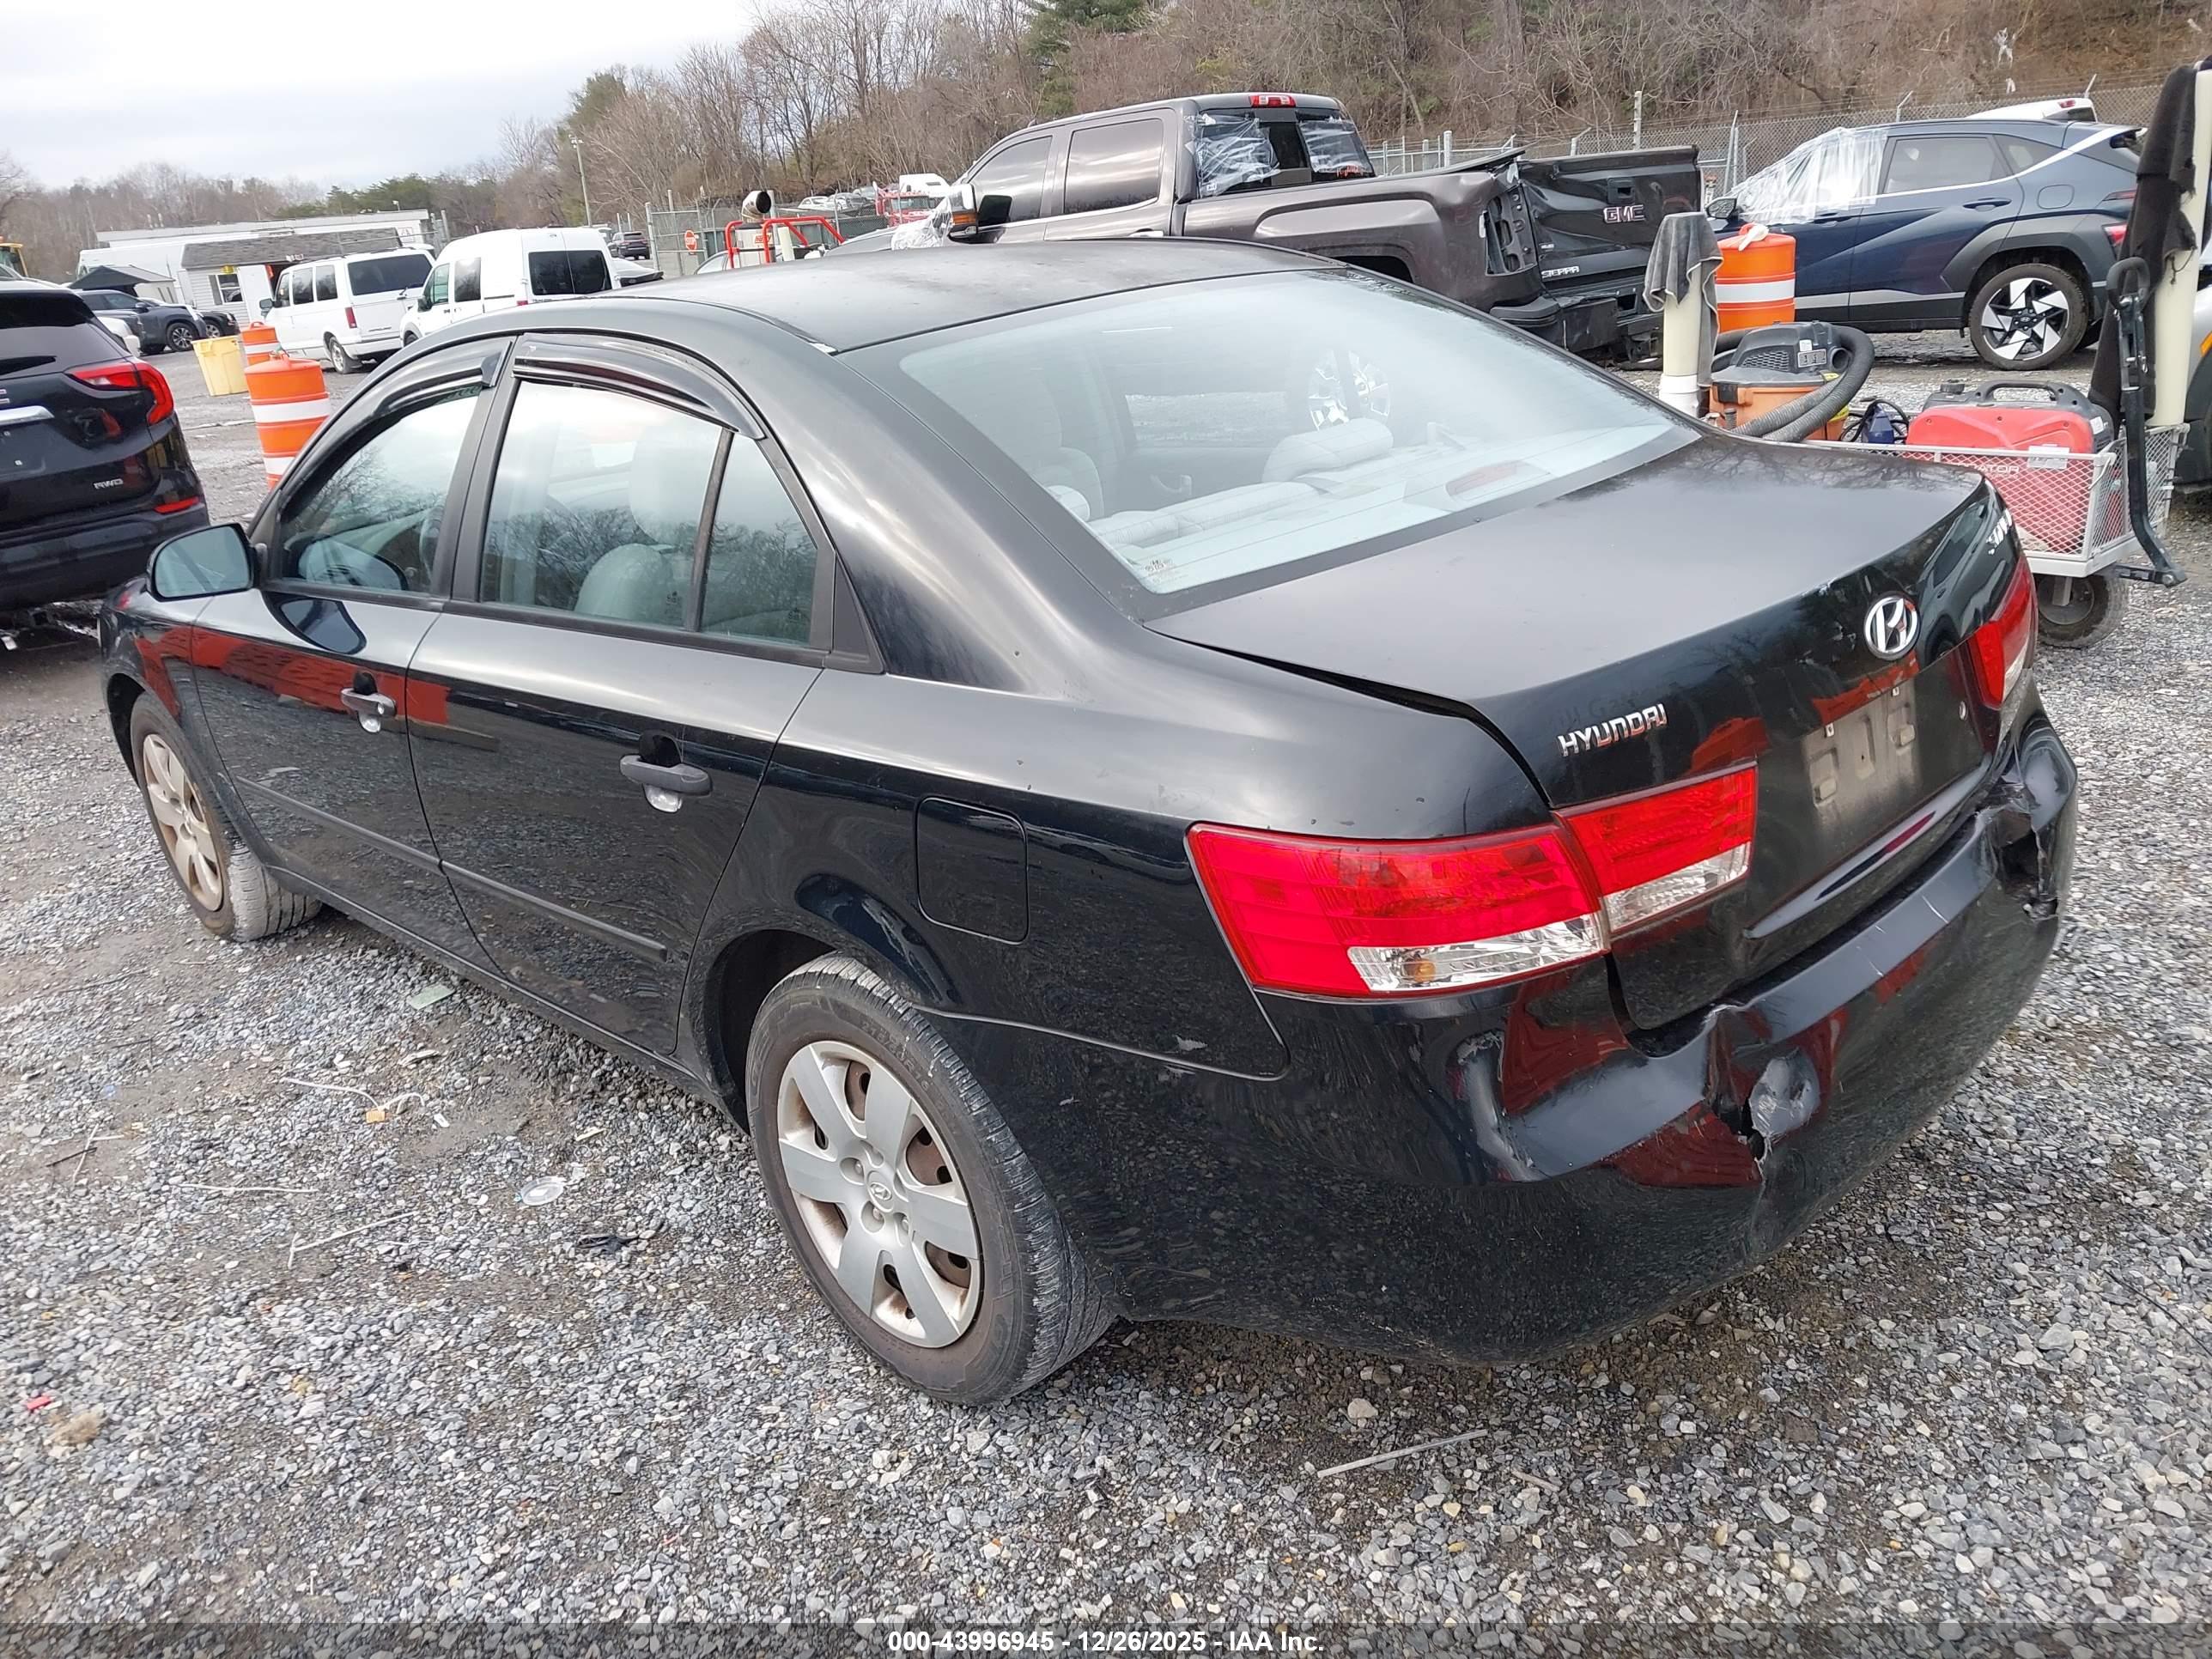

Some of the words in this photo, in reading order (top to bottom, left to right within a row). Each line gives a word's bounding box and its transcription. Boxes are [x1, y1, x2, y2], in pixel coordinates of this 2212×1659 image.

[1603, 204, 1646, 223] GMC
[1540, 265, 1580, 278] SIERRA
[1557, 703, 1668, 757] HYUNDAI
